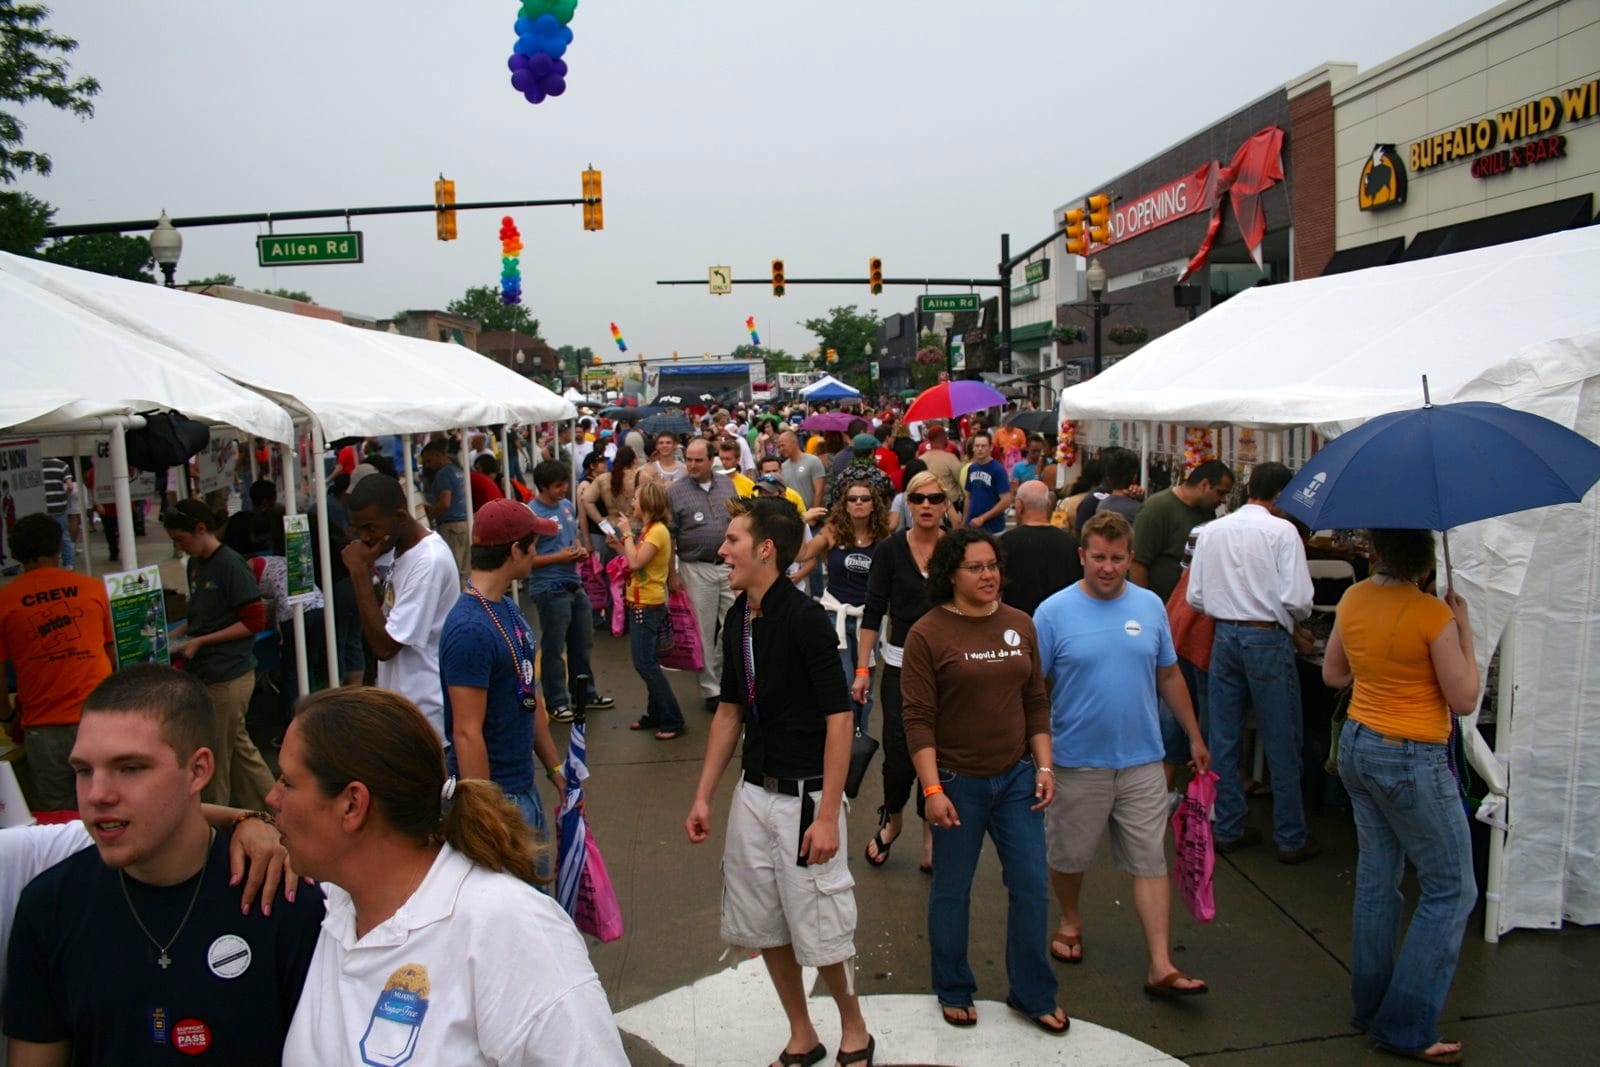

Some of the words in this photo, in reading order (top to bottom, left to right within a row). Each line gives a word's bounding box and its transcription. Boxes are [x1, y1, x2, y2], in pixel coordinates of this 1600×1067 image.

[1409, 118, 1492, 172] BUFFALO
[1495, 96, 1557, 143] WILD
[1471, 151, 1506, 179] GRILL
[1525, 134, 1562, 164] BAR
[1127, 182, 1187, 232] OPENING
[271, 242, 318, 256] Allen
[325, 240, 349, 254] Rd
[928, 299, 956, 308] Allen
[960, 298, 974, 307] Rd
[22, 585, 78, 607] CREW
[970, 650, 996, 660] would
[998, 649, 1009, 658] do
[178, 1033, 206, 1044] PASS
